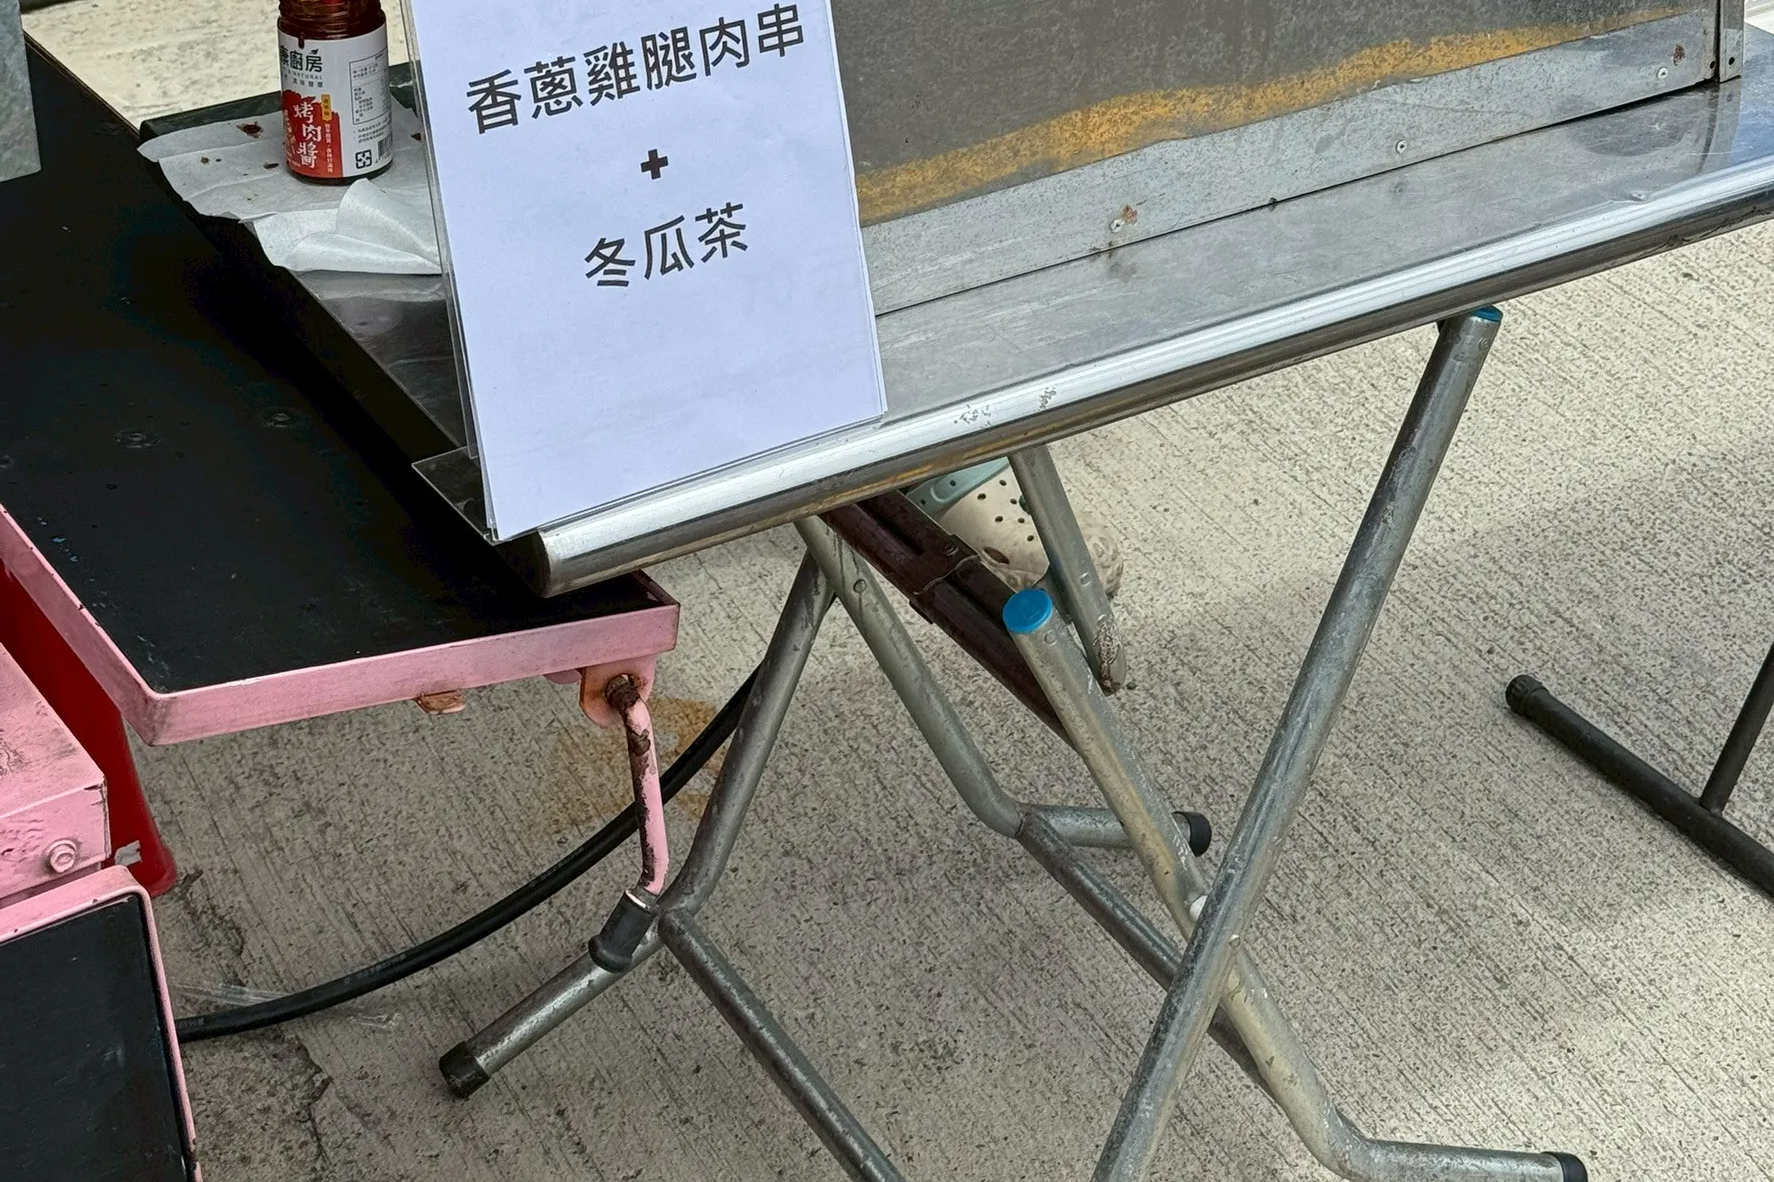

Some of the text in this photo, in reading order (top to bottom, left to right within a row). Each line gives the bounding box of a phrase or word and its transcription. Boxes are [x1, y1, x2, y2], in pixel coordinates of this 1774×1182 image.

[466, 3, 805, 135] 香蔥雞腿肉串
[293, 101, 321, 168] 烤肉醬
[584, 201, 749, 288] 冬瓜茶
